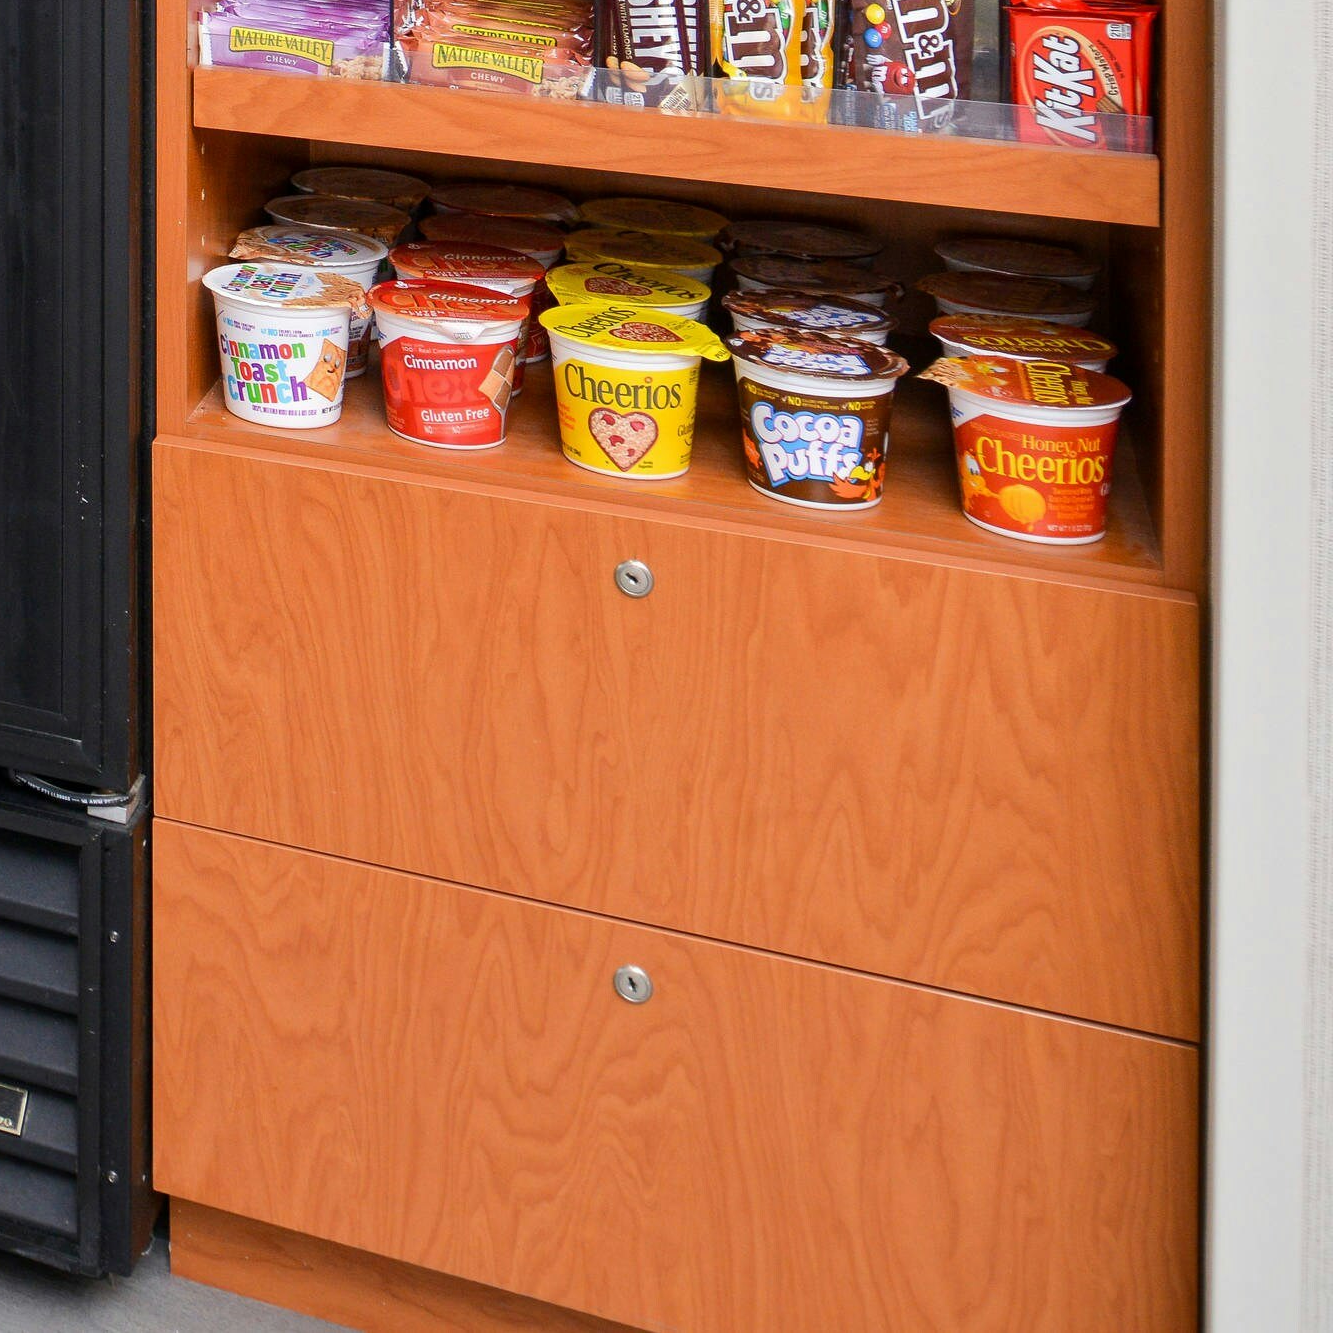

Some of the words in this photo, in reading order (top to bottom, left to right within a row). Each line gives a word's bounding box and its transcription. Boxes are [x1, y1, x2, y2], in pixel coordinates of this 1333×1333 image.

[619, 2, 628, 20] WITH
[234, 27, 284, 49] NATURE
[284, 33, 331, 63] VALLEY
[621, 20, 632, 59] ALMONDS
[265, 54, 298, 67] CHEWY
[438, 45, 490, 64] NATURE
[491, 50, 540, 80] VALLEY
[470, 71, 505, 84] CHEWY
[444, 253, 527, 262] Cinnamon
[593, 262, 703, 300] Cheerios
[428, 293, 519, 305] Cinnamon
[554, 306, 638, 339] Cheerios
[220, 334, 306, 360] Cinnamon
[230, 356, 289, 383] Toast
[403, 355, 477, 370] Cinnamon
[228, 374, 308, 405] Crunch
[564, 362, 683, 410] Cheerios
[1026, 362, 1073, 405] Cheerios
[421, 409, 463, 423] Gluten
[465, 407, 490, 420] Free
[787, 396, 802, 407] NO
[847, 402, 861, 411] NO
[751, 402, 860, 450] Cocoa
[1021, 434, 1074, 457] Honey
[1078, 437, 1100, 454] Nut
[761, 441, 860, 482] Puffs
[976, 435, 1105, 485] Cheerios
